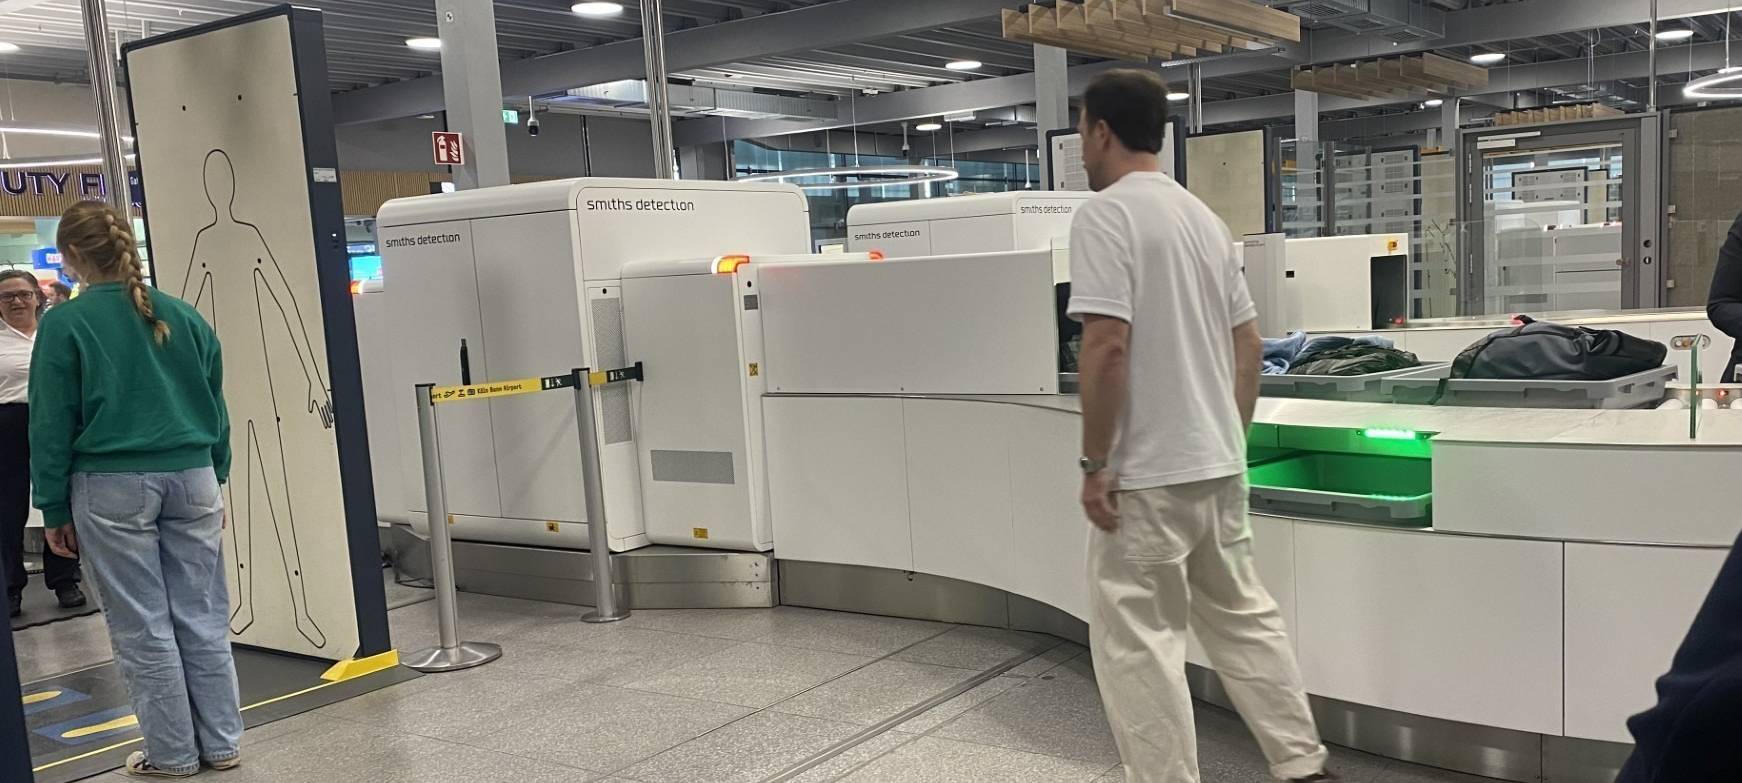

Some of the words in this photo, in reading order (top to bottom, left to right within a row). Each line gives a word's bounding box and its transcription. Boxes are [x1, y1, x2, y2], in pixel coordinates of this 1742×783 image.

[586, 198, 633, 210] smiths
[635, 198, 694, 211] detection
[1020, 205, 1043, 214] smiths
[1043, 205, 1072, 214] detection
[385, 236, 416, 248] smiths
[417, 233, 461, 245] detection
[854, 232, 881, 241] smiths
[882, 229, 920, 239] detection
